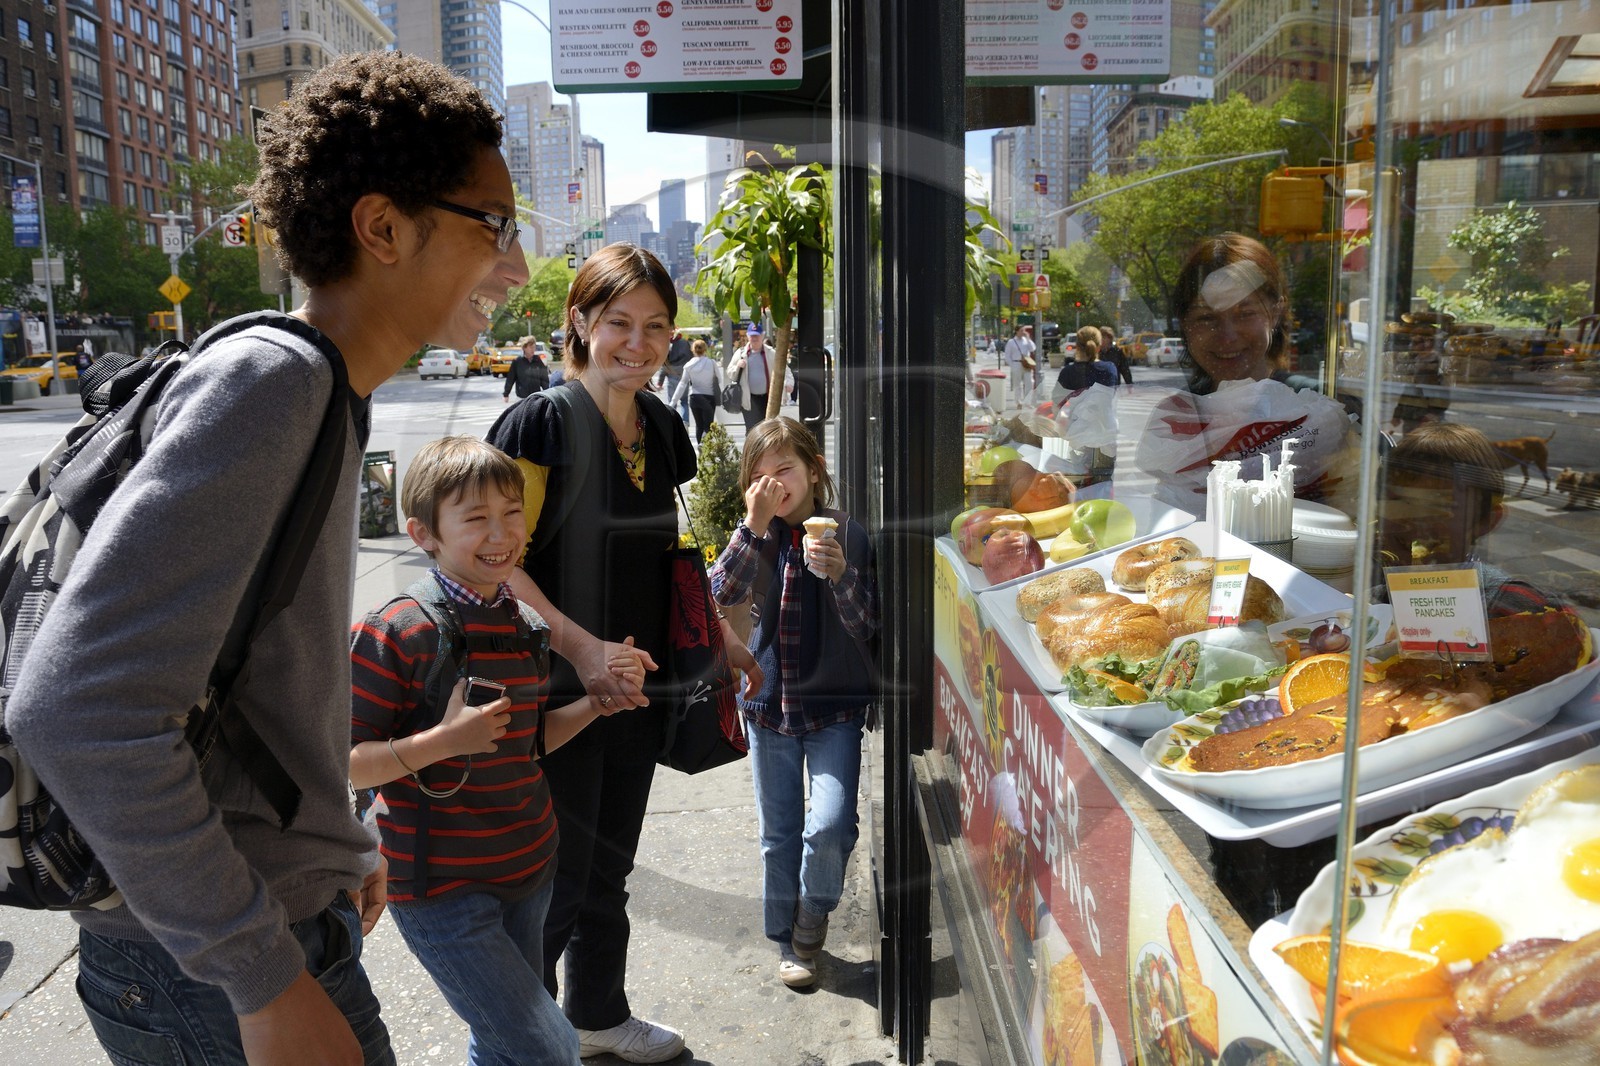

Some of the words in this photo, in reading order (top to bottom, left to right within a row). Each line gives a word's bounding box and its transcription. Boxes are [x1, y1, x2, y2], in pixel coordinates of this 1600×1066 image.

[657, 6, 673, 14] 5.50
[633, 25, 650, 33] 5.50
[776, 21, 792, 29] 5.95
[641, 45, 657, 53] 5.50
[775, 42, 791, 50] 5.50
[625, 66, 640, 74] 5.50
[770, 63, 786, 71] 5.95
[165, 237, 180, 246] 30
[1410, 577, 1449, 585] BREAKFAST
[1410, 598, 1434, 607] FRESH
[1435, 597, 1456, 606] FRUIT
[1415, 609, 1456, 618] PANCAKES
[940, 675, 989, 808] BREAKFAST
[1013, 687, 1080, 850] DINNER
